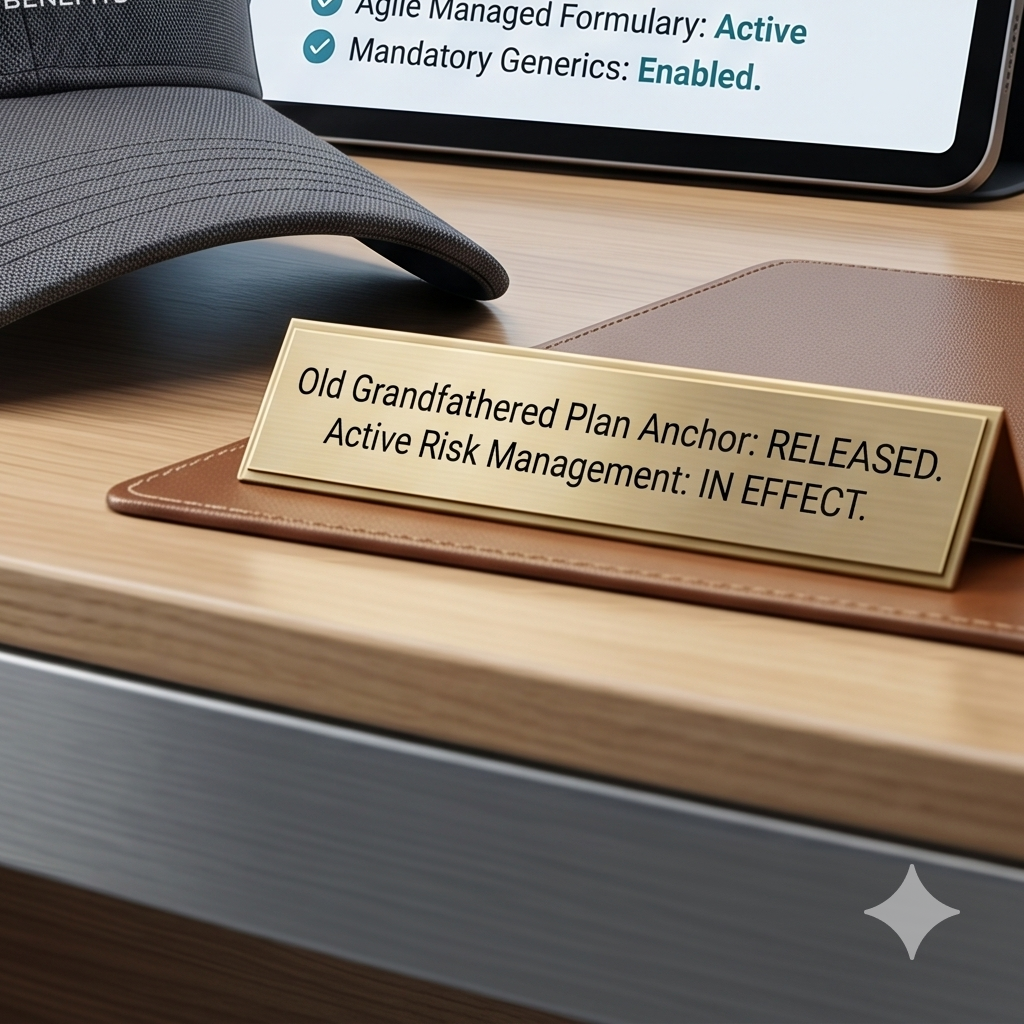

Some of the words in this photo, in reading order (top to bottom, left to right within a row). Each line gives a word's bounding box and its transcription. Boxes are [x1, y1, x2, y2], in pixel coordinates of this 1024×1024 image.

[349, 36, 493, 78] Mandatory
[500, 46, 629, 81] Generics:
[638, 56, 761, 91] Enabled.
[559, 3, 707, 44] Formulary:
[713, 13, 807, 45] Active
[298, 366, 347, 400] Old
[352, 373, 560, 429] Grandfathered
[564, 401, 631, 439] Plan
[637, 412, 759, 457] Anchor:
[766, 428, 942, 482] RELEASED.
[322, 417, 412, 455] Active
[418, 429, 481, 466] Risk
[486, 439, 691, 496] Management:
[698, 468, 735, 502] IN
[740, 474, 868, 521] EFFECT.
